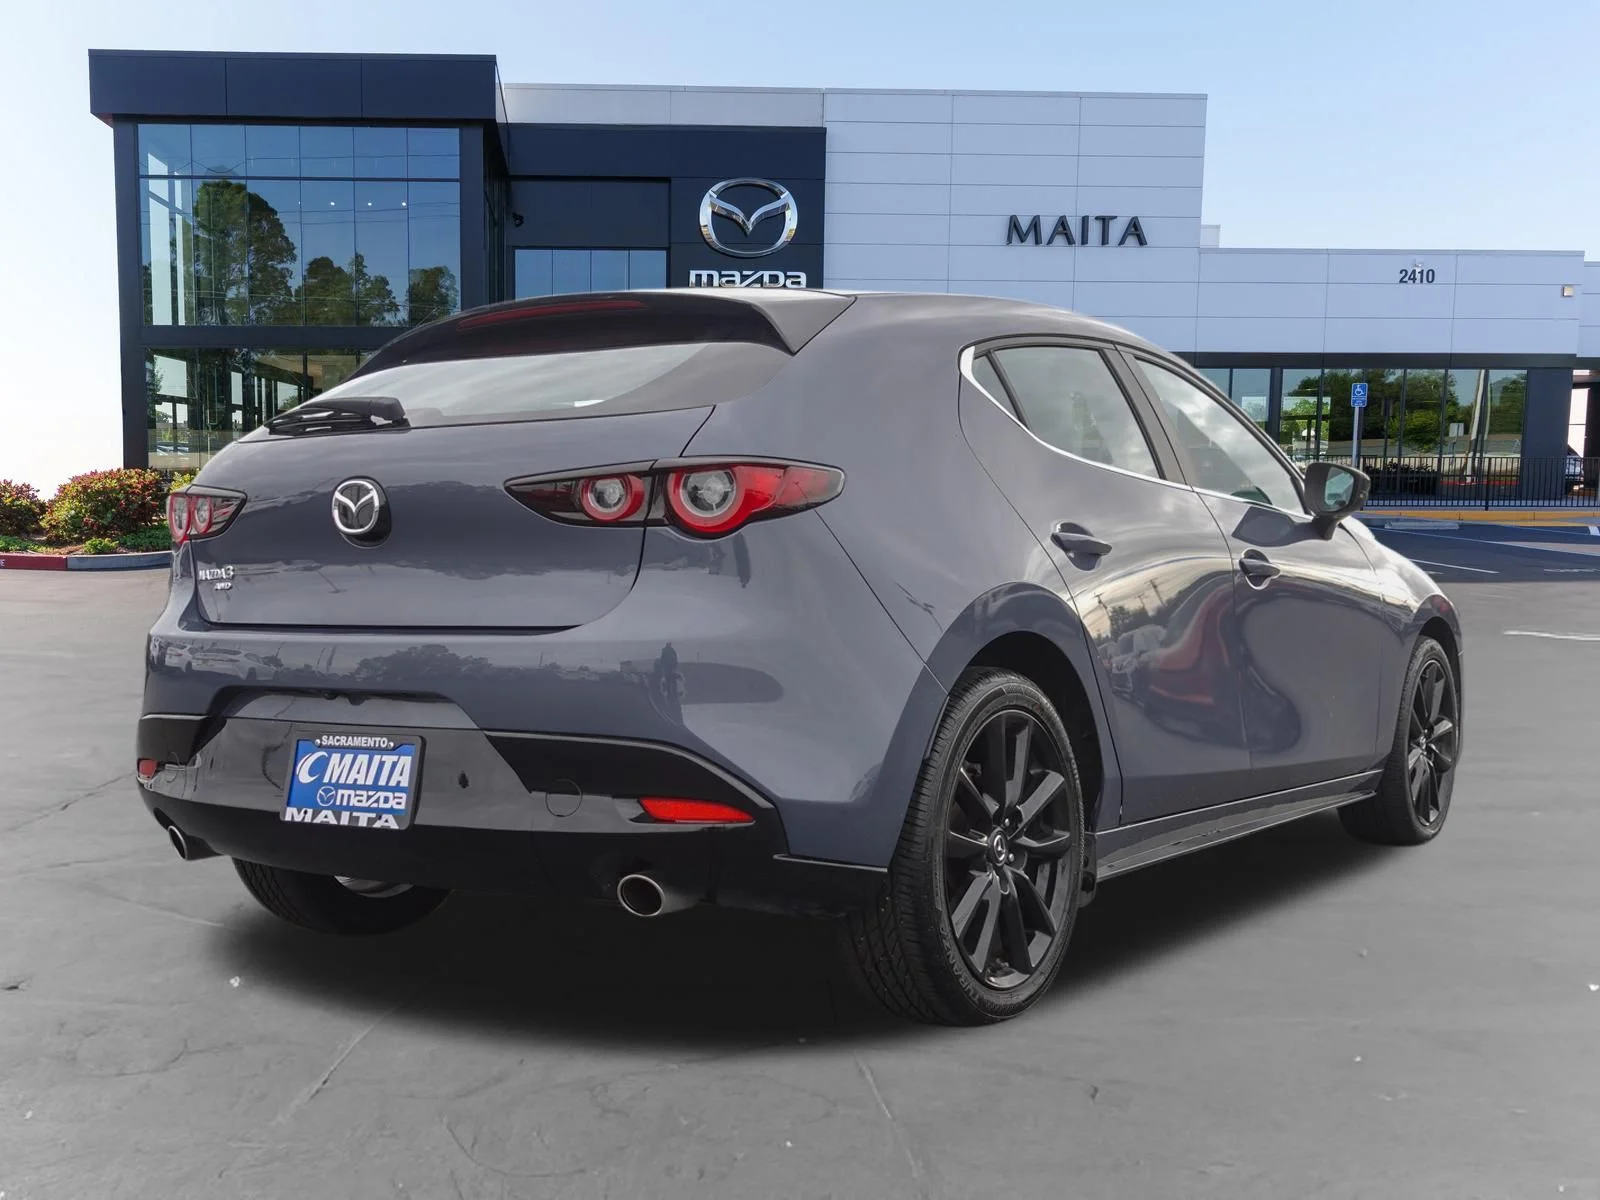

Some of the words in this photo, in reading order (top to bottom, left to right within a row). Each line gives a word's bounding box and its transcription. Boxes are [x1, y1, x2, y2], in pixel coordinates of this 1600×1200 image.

[1006, 214, 1148, 247] MAITA
[688, 269, 808, 288] mazda
[1399, 268, 1436, 284] 2410
[321, 735, 388, 748] SACRAMENTO
[322, 752, 413, 787] MAITA
[335, 788, 407, 809] mazda
[284, 806, 400, 830] MAITA
